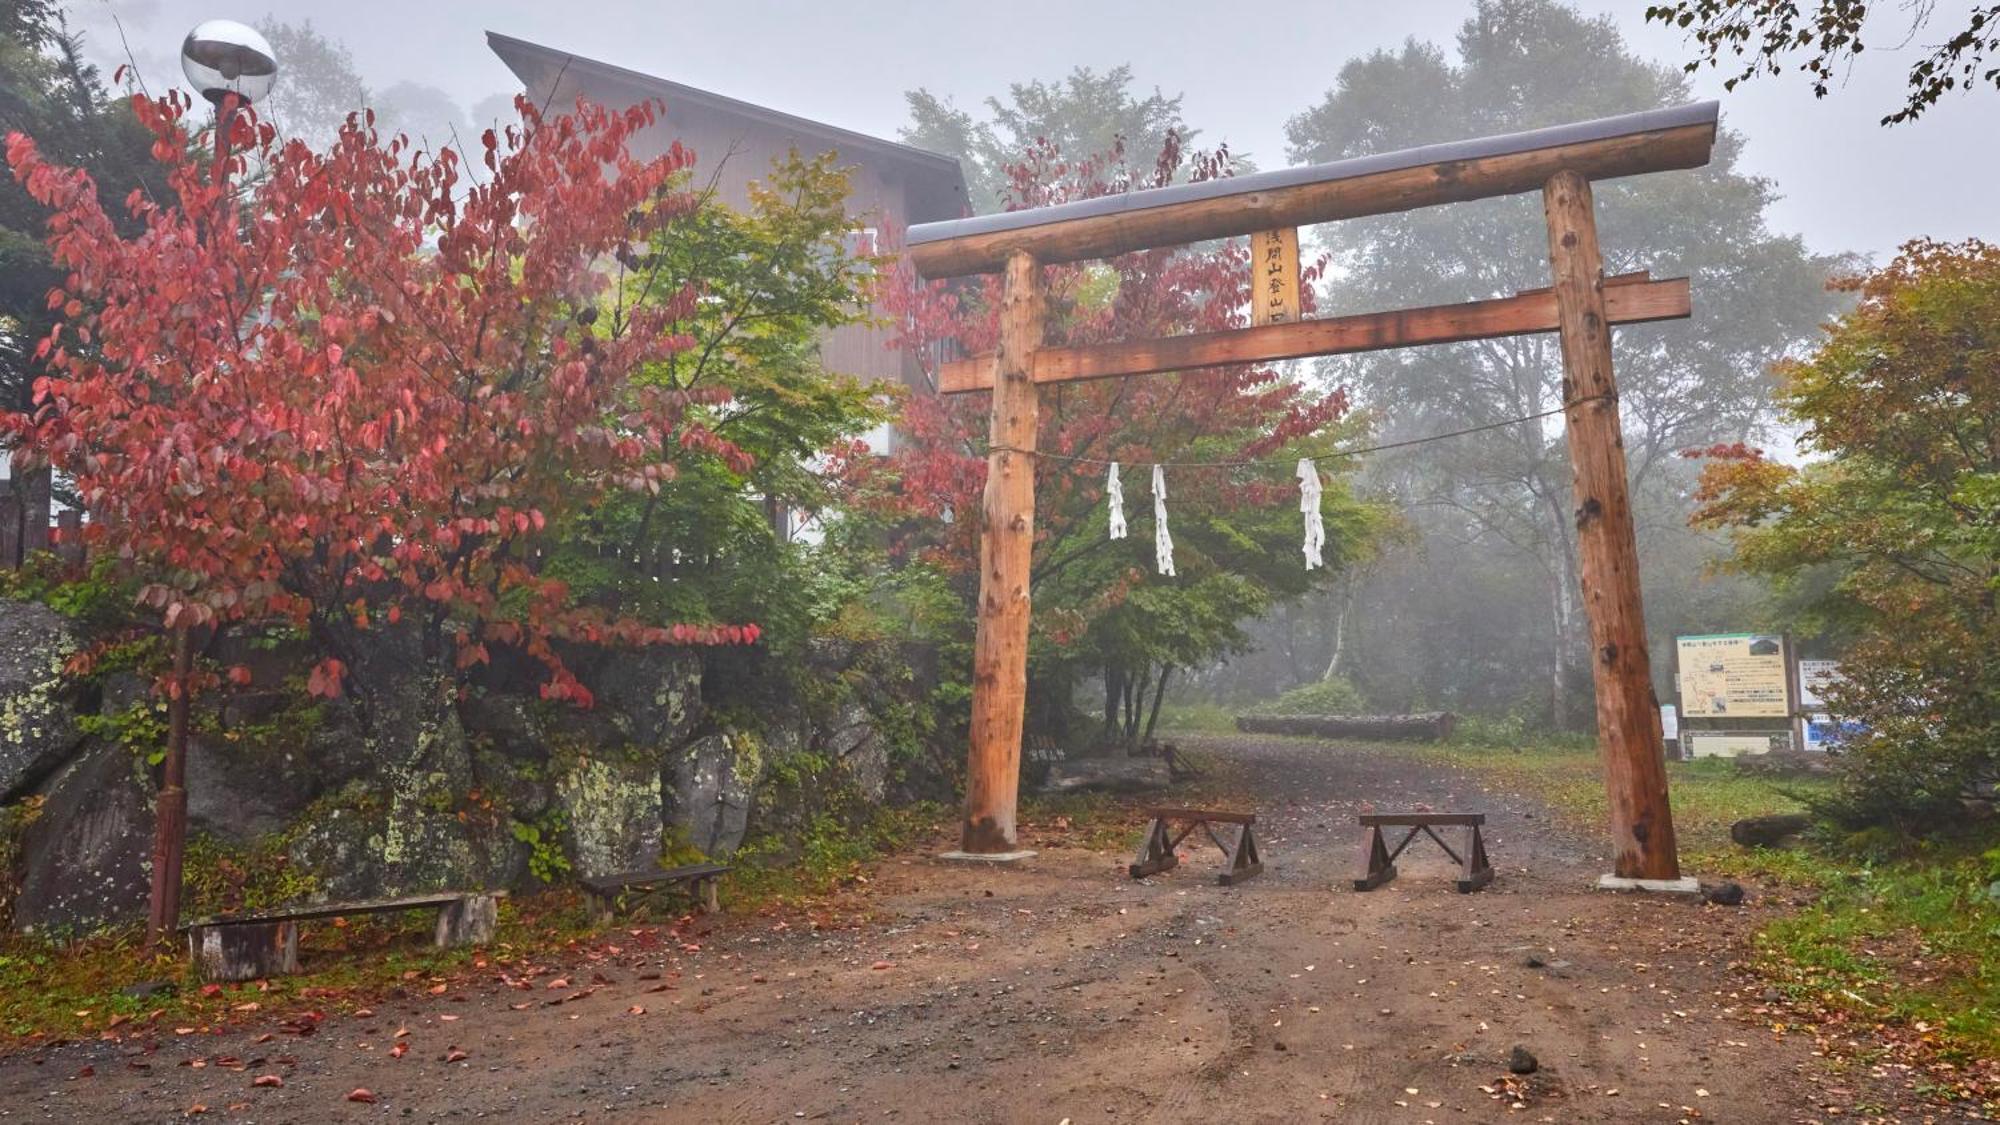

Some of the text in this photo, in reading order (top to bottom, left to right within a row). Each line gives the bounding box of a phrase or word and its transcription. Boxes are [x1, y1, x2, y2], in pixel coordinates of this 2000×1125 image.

[1265, 231, 1285, 322] 浅間山登山口
